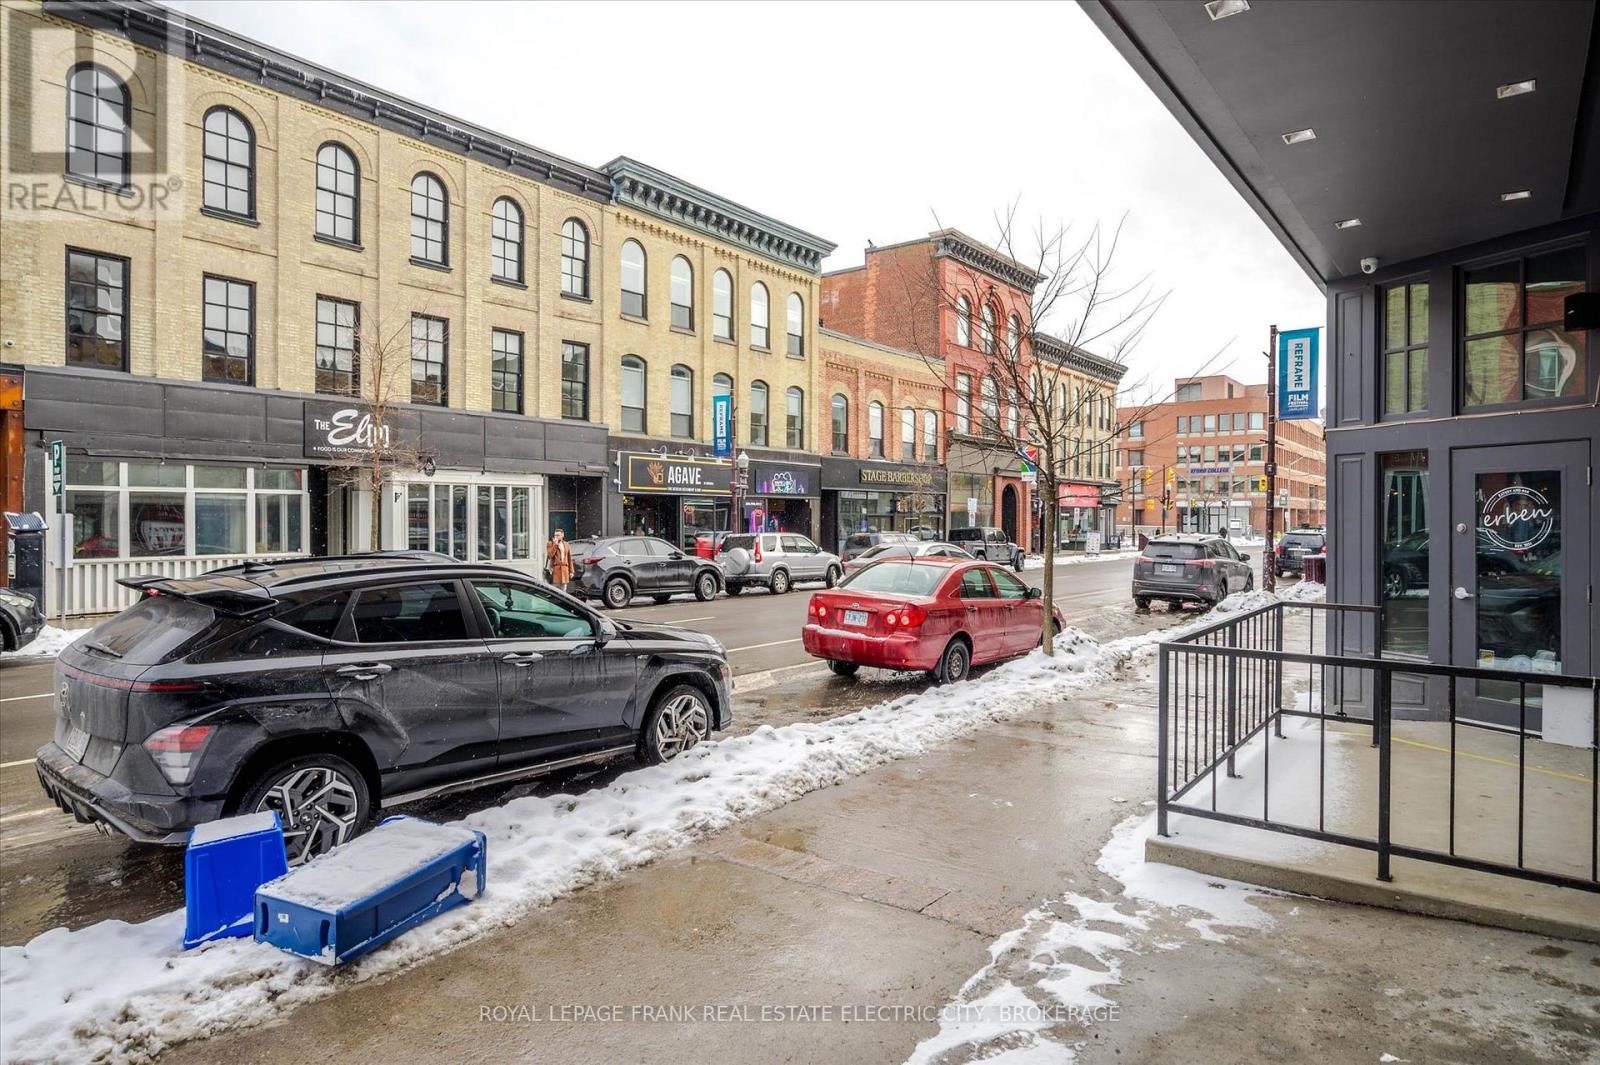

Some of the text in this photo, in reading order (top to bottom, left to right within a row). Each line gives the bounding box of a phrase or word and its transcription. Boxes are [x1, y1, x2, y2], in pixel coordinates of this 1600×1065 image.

[1294, 342, 1304, 388] REFRAME
[1288, 394, 1309, 402] FILM
[314, 419, 331, 431] THE
[54, 444, 60, 467] P
[667, 465, 702, 485] AGAVE
[862, 469, 887, 482] STAGE
[1208, 466, 1229, 474] COLLEGE
[1483, 506, 1552, 527] erben
